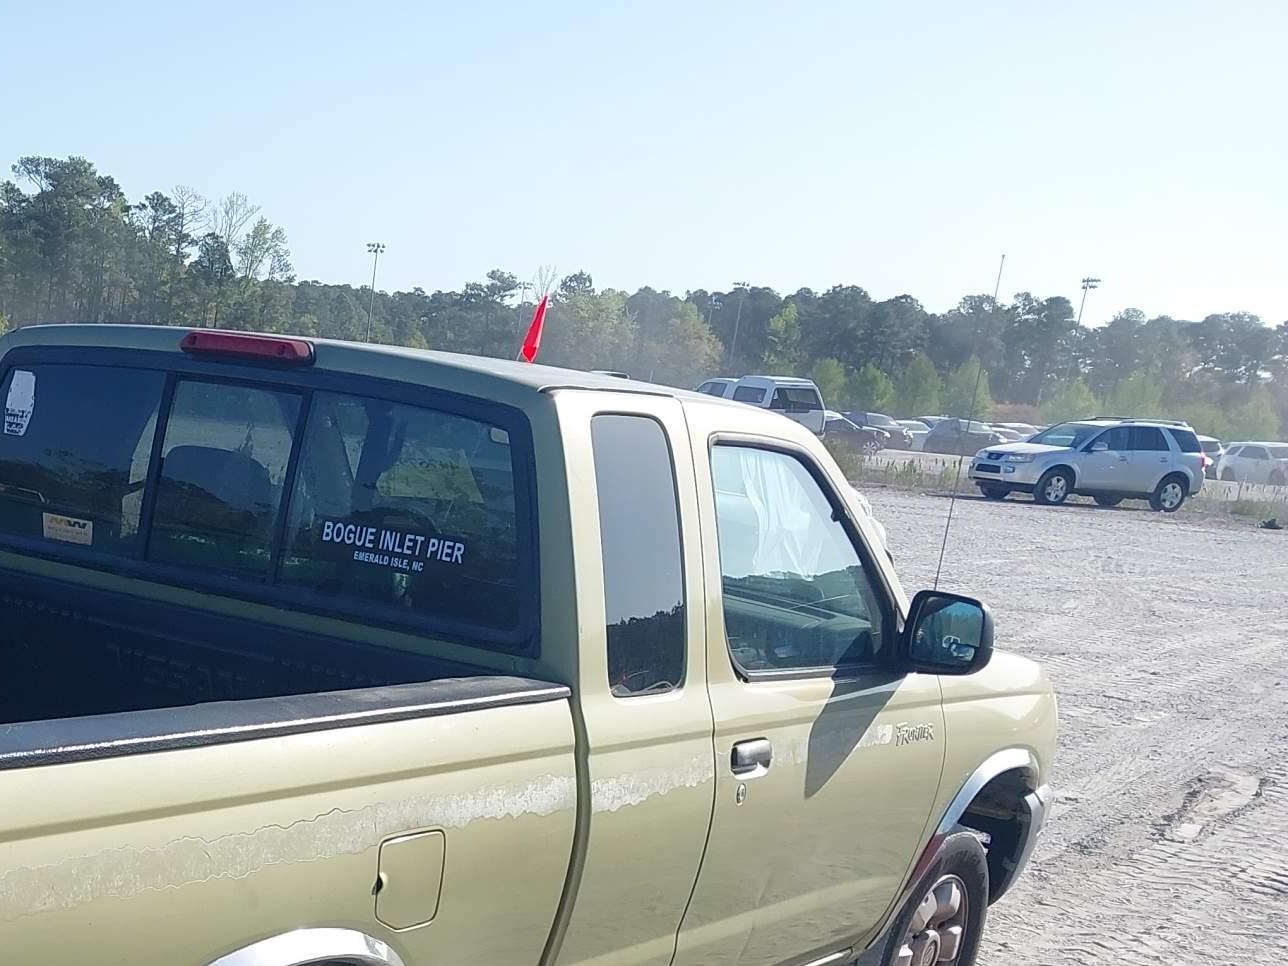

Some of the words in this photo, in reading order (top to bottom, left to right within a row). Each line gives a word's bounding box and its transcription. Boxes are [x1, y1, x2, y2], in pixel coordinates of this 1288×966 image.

[322, 521, 377, 548] BOGUE
[378, 529, 425, 556] INLET
[426, 538, 465, 564] PIER
[353, 550, 389, 566] EMERALD
[390, 556, 410, 571] ISLE,
[412, 561, 424, 572] NC
[895, 721, 934, 747] FRONTIER
